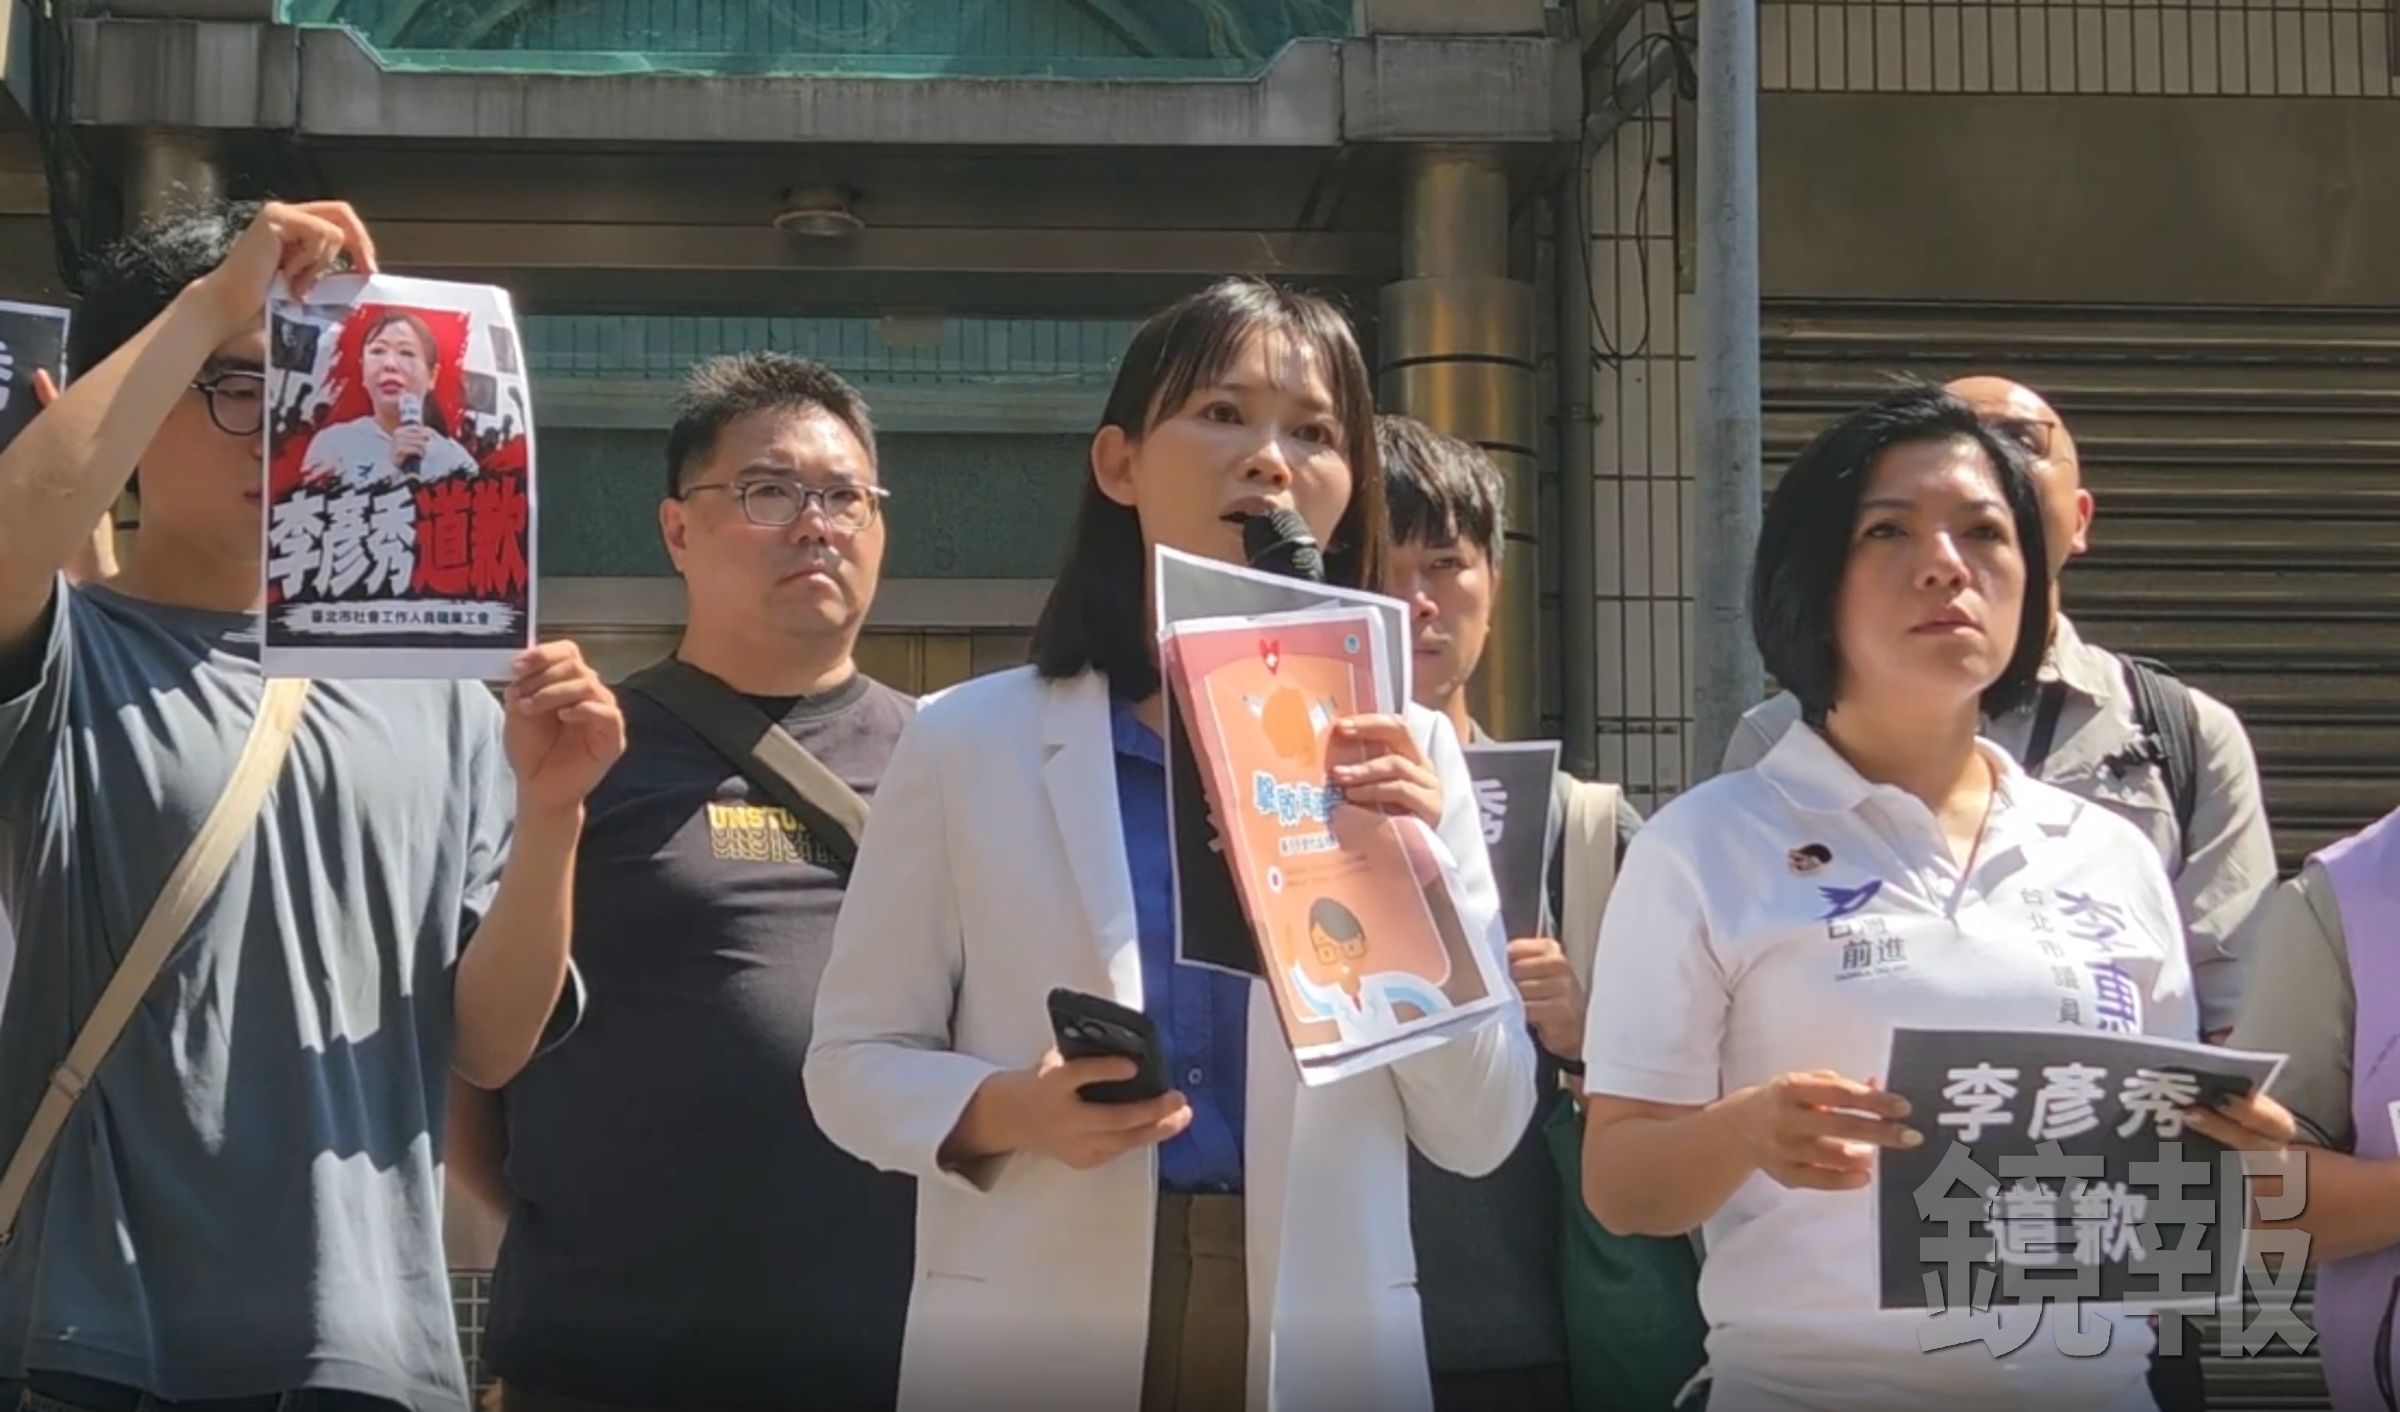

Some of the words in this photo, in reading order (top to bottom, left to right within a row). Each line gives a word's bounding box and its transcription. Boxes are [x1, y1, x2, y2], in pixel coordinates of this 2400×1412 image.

[310, 609, 490, 627] 臺北市社會工作人員職業工會
[1842, 937, 1907, 970] 前進
[2019, 886, 2082, 1027] 台北市議員
[1937, 1062, 2203, 1142] 李彥秀
[1984, 1180, 2149, 1266] 道歉
